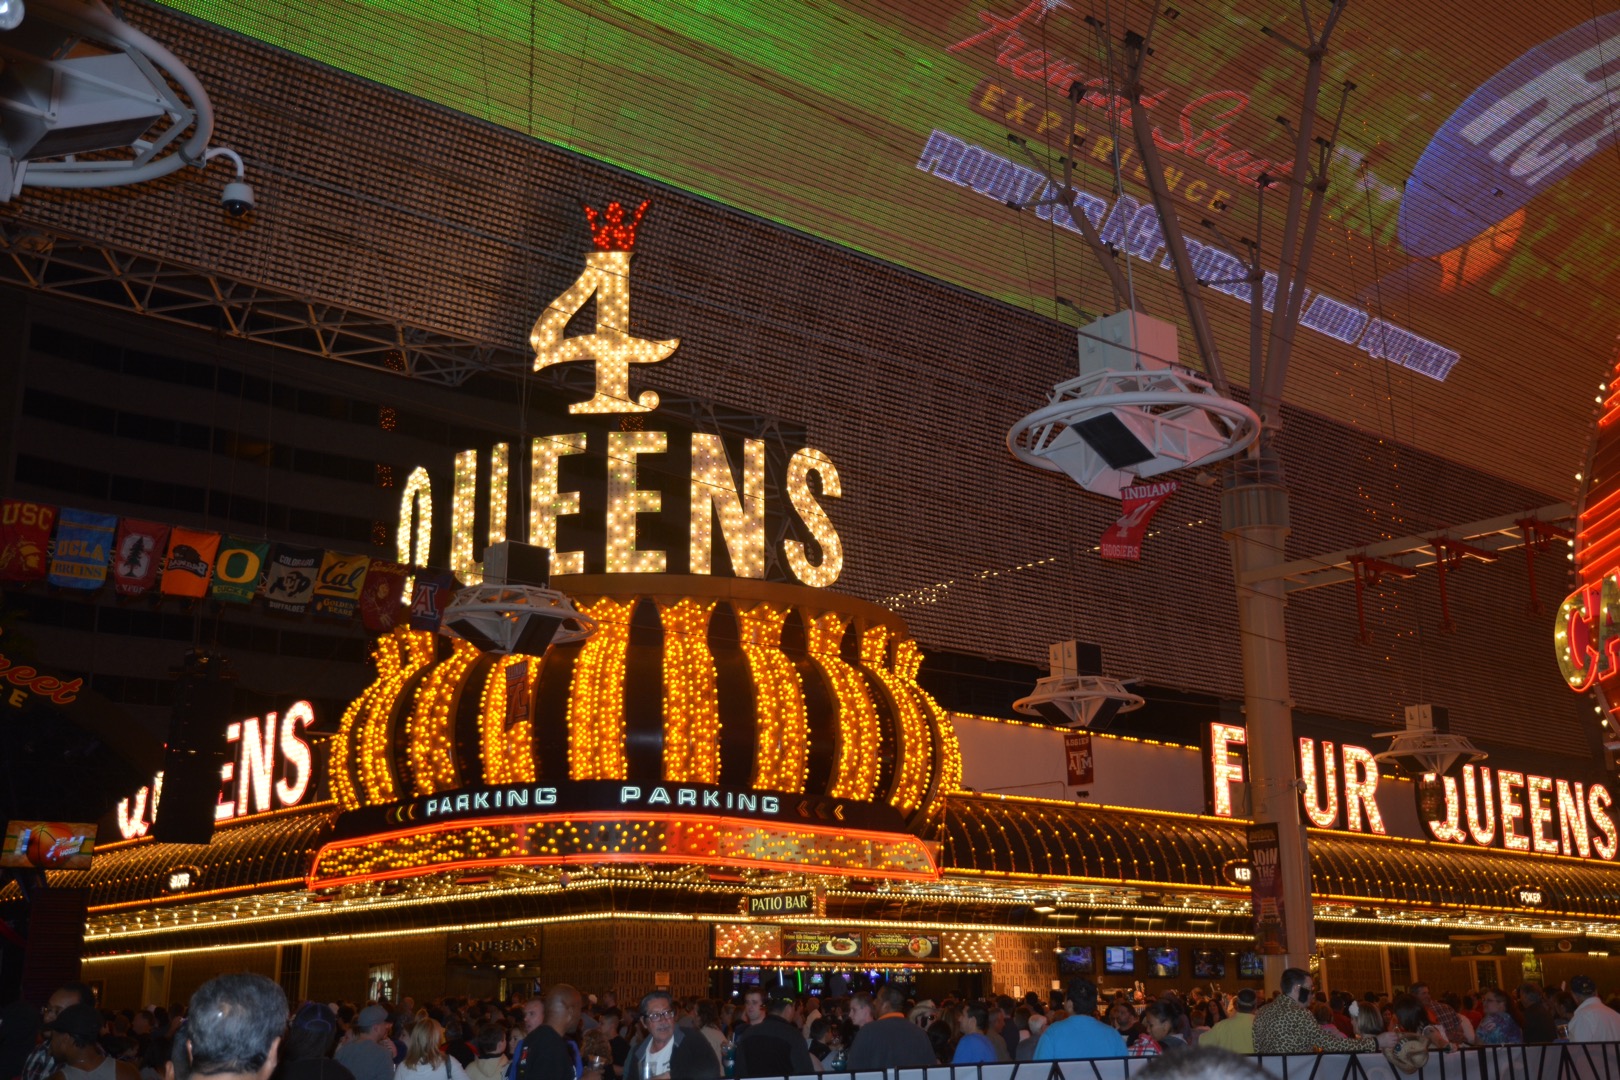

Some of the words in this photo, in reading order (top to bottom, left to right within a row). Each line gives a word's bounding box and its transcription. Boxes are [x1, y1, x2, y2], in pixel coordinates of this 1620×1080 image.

[1151, 90, 1297, 189] Street
[1299, 293, 1369, 346] AUDIO
[530, 251, 681, 414] 4
[1123, 482, 1178, 500] INDIANA
[2, 503, 53, 531] USC
[397, 432, 843, 604] QUEENS
[57, 540, 105, 562] UCLA
[1101, 543, 1139, 558] HOOSIERS
[279, 554, 315, 568] COLORADO
[54, 563, 104, 578] BRUINS
[320, 561, 365, 590] Cal
[269, 601, 305, 614] BUFFALOES
[323, 598, 355, 610] GOLDEN
[621, 786, 780, 814] PARKING
[1211, 722, 1386, 834] FUR
[1422, 764, 1618, 860] QUEENS
[426, 787, 558, 817] PARKING
[752, 896, 782, 911] PATIO
[785, 895, 808, 908] BAR
[1520, 891, 1542, 903] POKER
[466, 937, 537, 953] QUEENS
[796, 943, 819, 951] $12.99
[881, 948, 899, 956] $6.99
